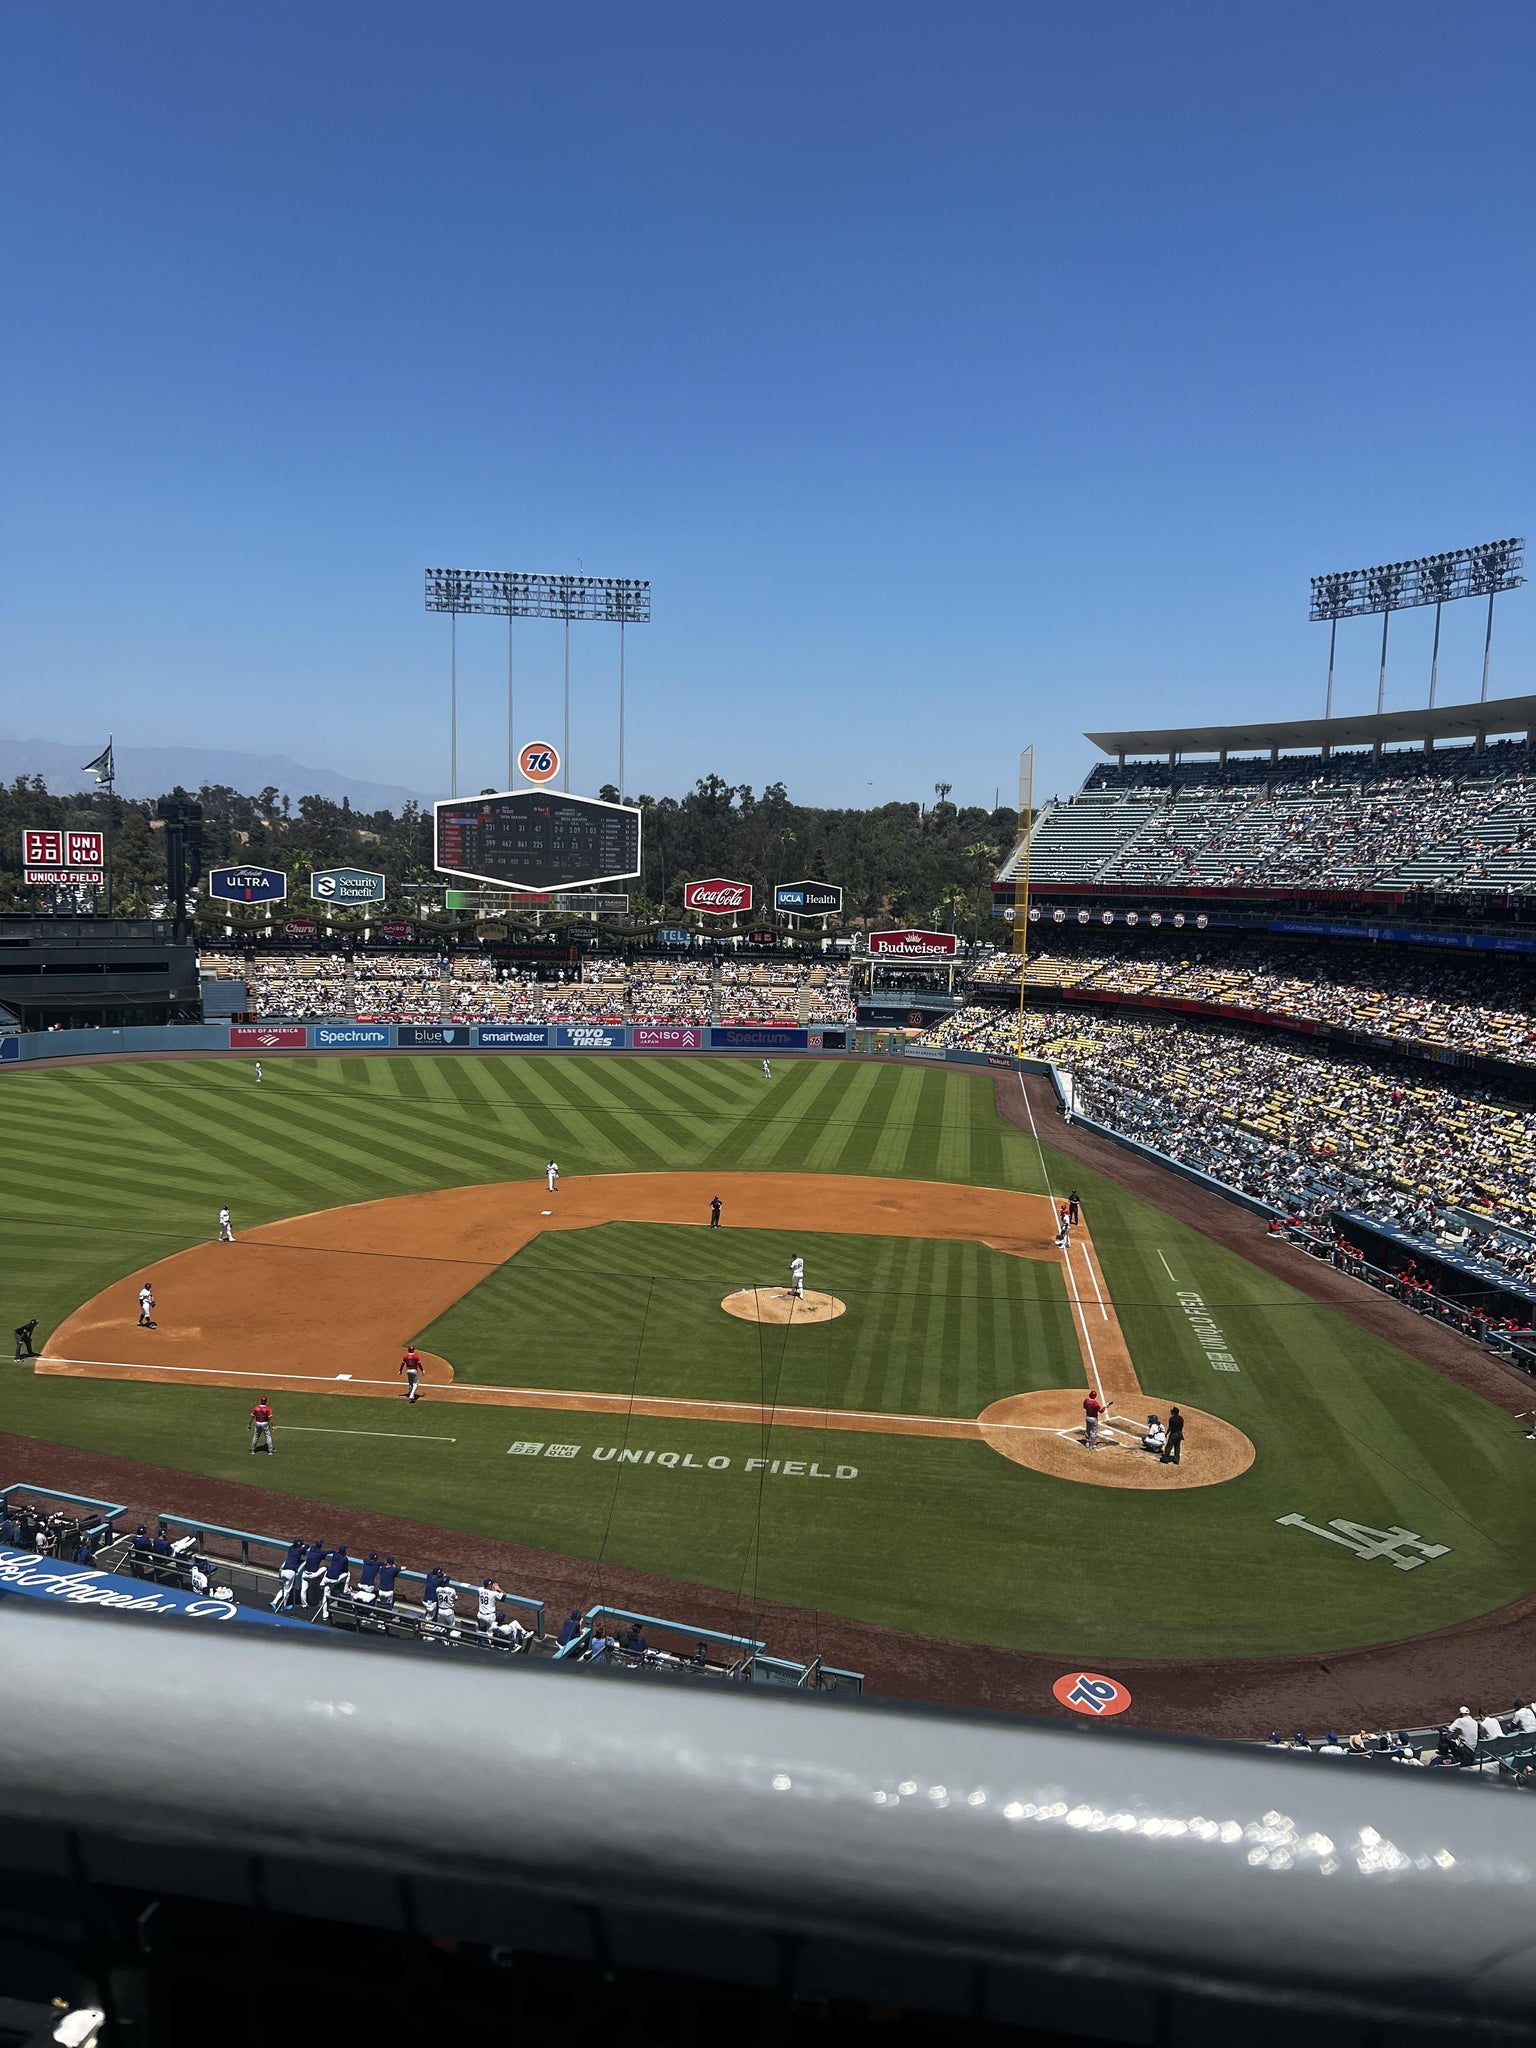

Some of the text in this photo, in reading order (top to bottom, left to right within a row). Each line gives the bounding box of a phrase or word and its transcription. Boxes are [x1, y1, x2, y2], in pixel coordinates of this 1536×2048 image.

[526, 751, 553, 772] 76
[72, 837, 96, 849] UNI
[72, 850, 99, 862] QLO
[30, 872, 99, 884] UNIQLO FIELD
[226, 877, 270, 888] ULTRA
[339, 877, 378, 889] Security
[340, 887, 373, 897] Benefit
[691, 887, 746, 906] Coca-Cola
[780, 894, 837, 904] UCLA Health
[285, 923, 315, 934] Churu
[878, 941, 948, 954] Budweiser
[909, 1012, 921, 1024] 76
[320, 1030, 381, 1044] Spectrum
[415, 1029, 442, 1040] blue
[482, 1032, 545, 1042] smartwater
[567, 1028, 604, 1037] TOYO
[640, 1031, 679, 1040] DAISO
[727, 1031, 786, 1045] Spectrum
[572, 1037, 613, 1046] TIRES
[809, 1035, 821, 1045] 76
[988, 1057, 1011, 1066] Yakult
[592, 1447, 859, 1480] UNIQLO FIELD
[1066, 1674, 1118, 1714] 76
